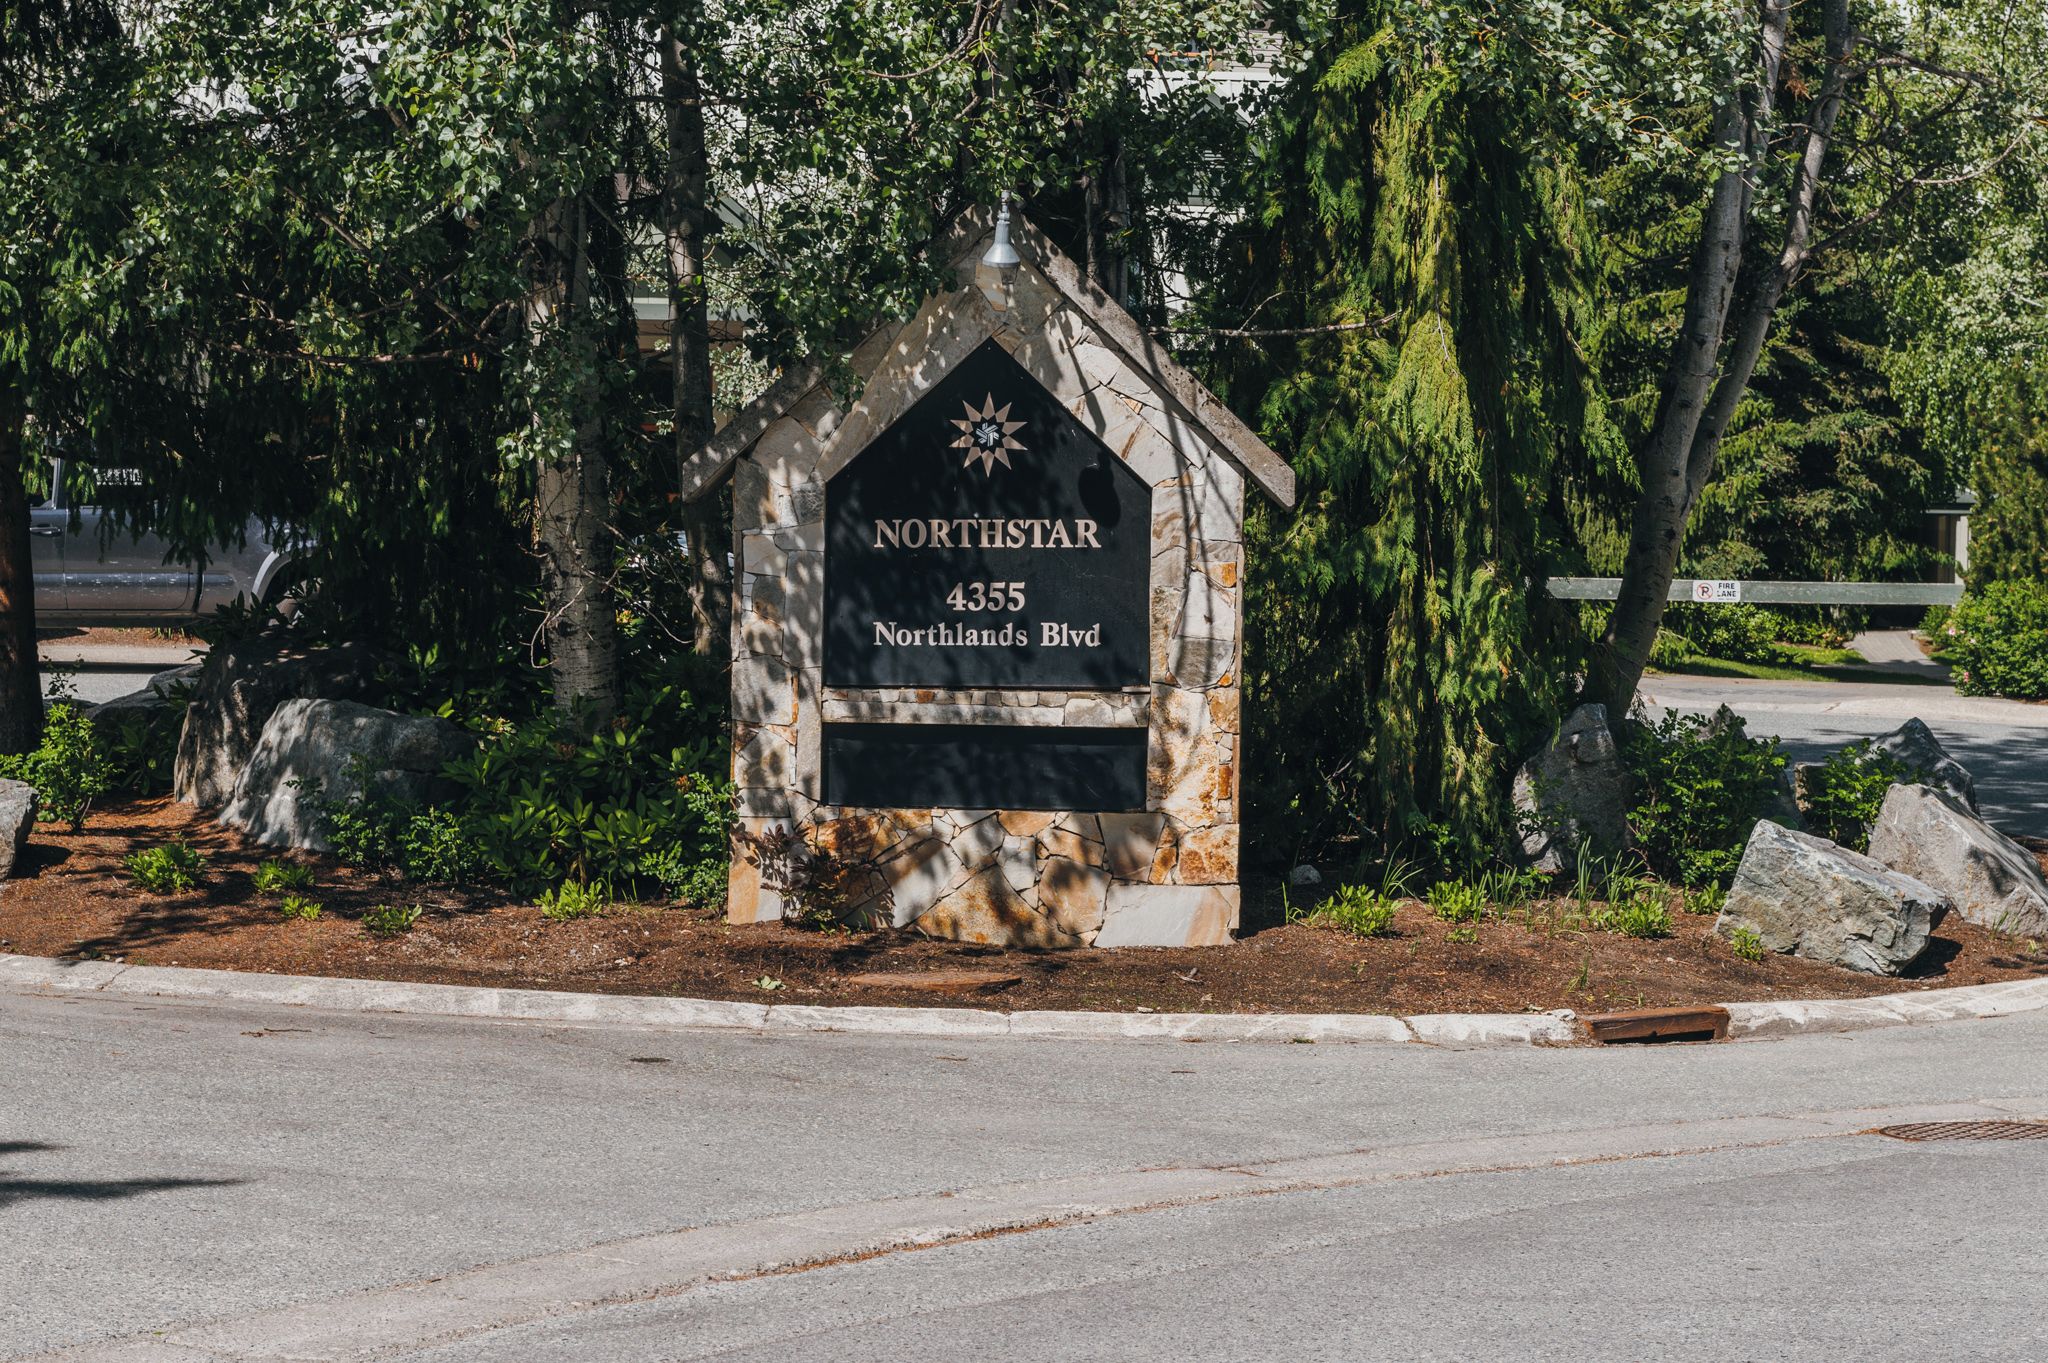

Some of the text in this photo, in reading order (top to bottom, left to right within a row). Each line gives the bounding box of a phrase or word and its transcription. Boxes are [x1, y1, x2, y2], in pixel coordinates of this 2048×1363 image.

[873, 518, 1102, 549] NORTHSTAR
[946, 581, 1026, 612] 4355
[873, 621, 1102, 648] Northlands Blvd
